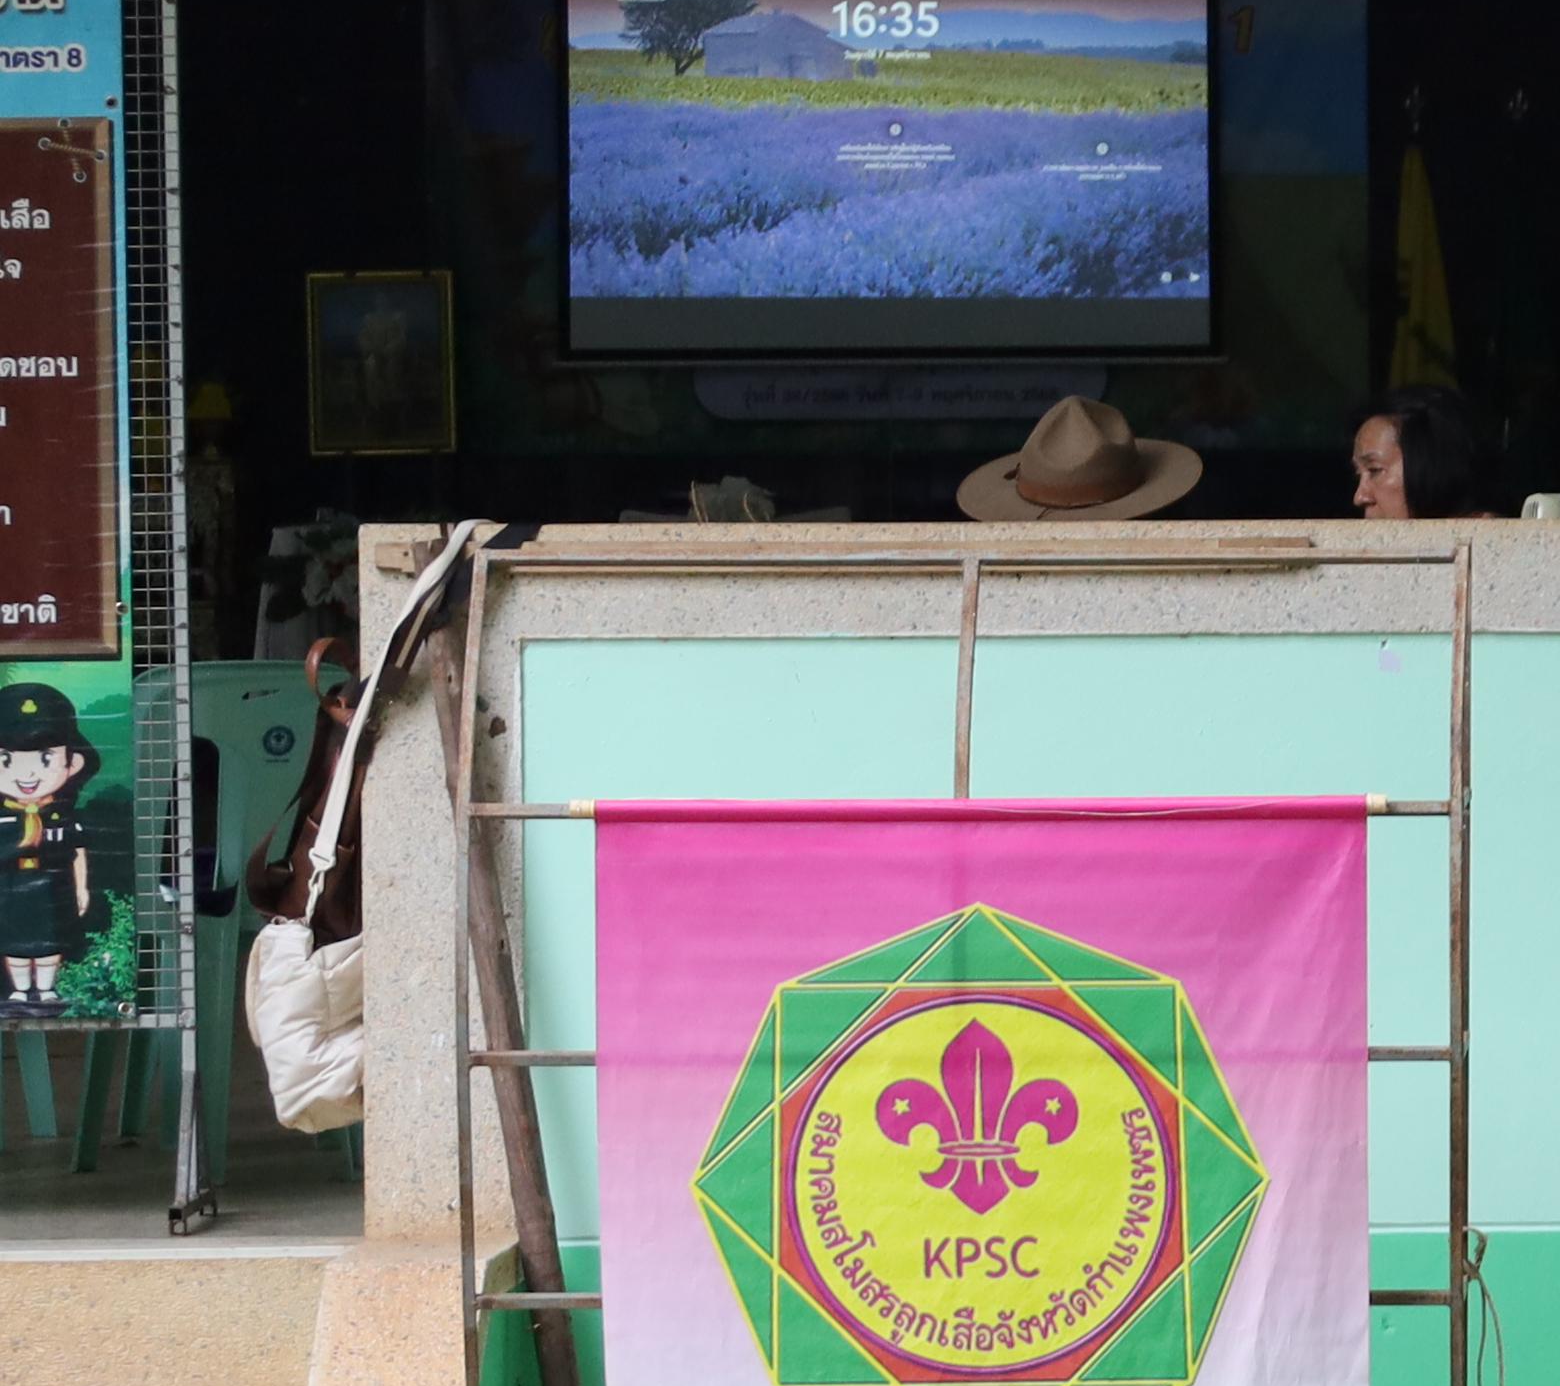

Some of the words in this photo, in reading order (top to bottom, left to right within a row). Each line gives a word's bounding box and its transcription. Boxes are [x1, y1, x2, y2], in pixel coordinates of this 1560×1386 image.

[832, 0, 940, 38] 16:35
[67, 47, 82, 68] 8
[924, 1236, 1041, 1279] KPSC
